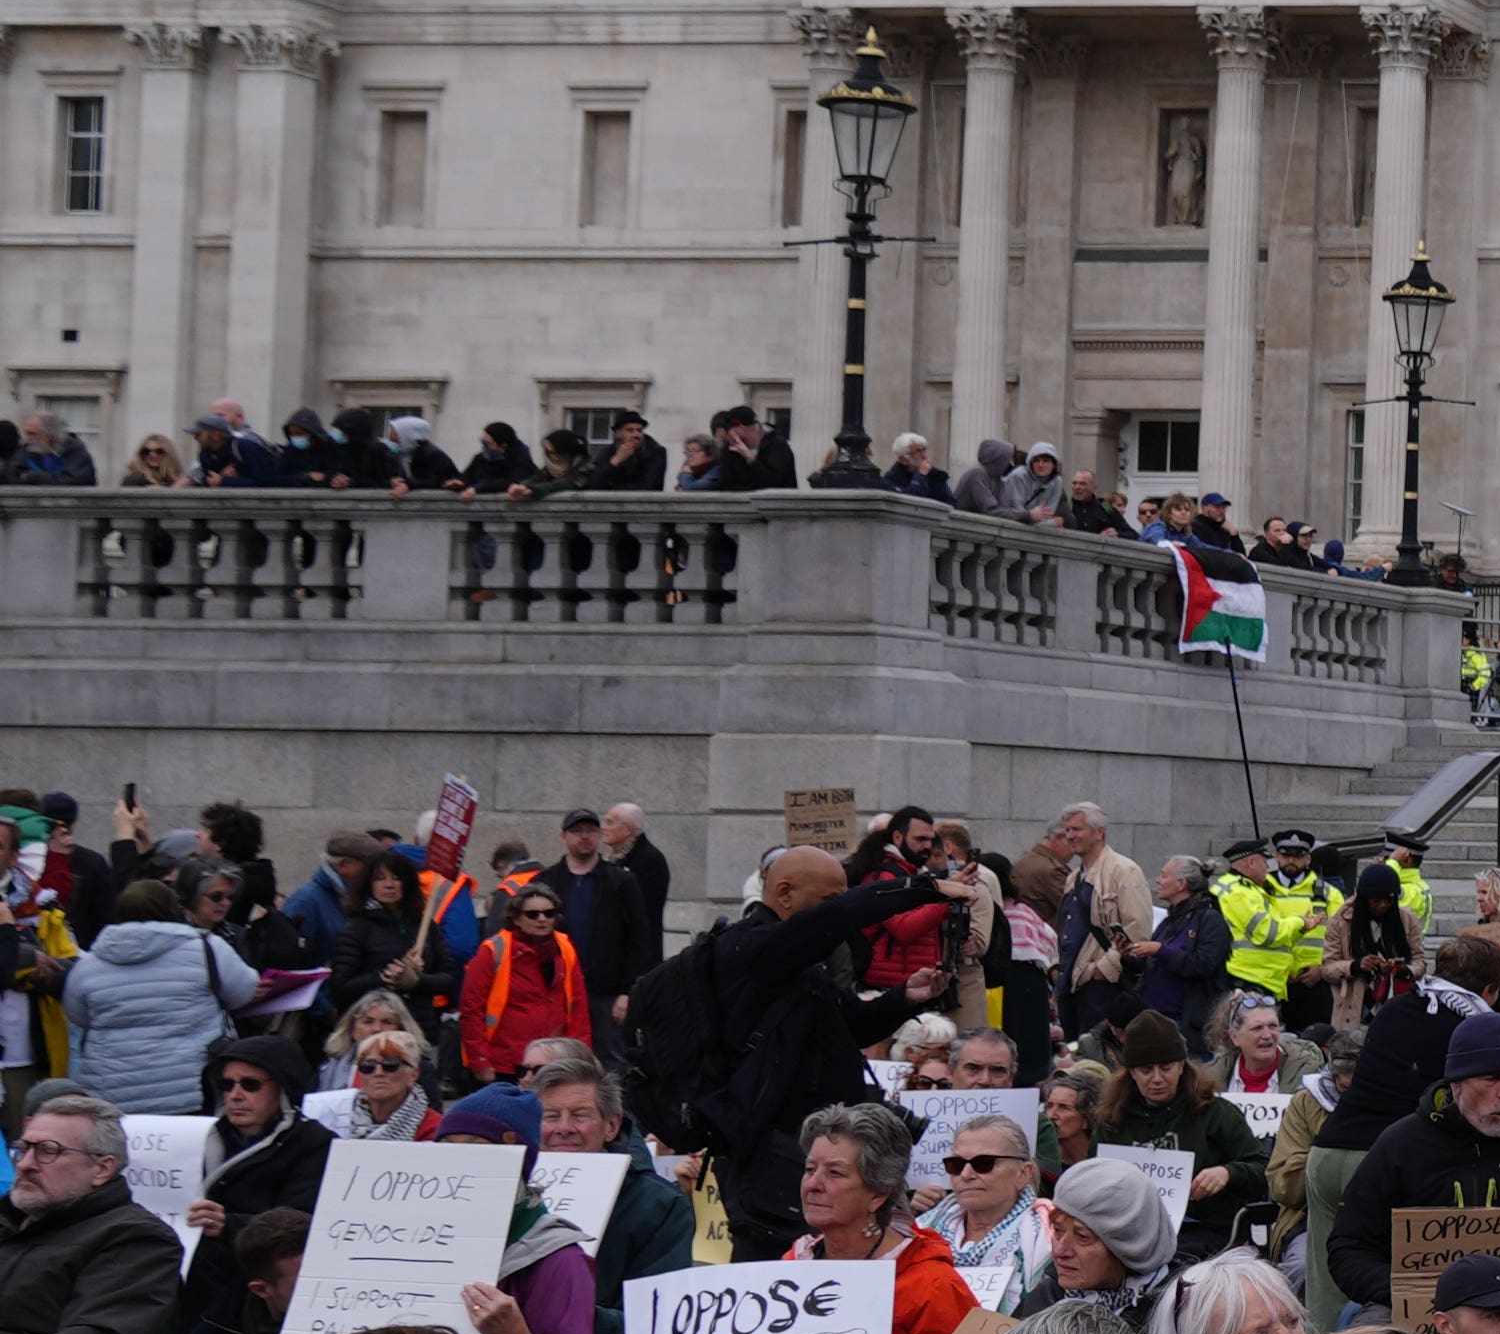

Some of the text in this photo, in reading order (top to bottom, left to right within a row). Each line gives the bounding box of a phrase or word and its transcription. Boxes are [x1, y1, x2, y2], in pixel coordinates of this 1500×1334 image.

[343, 1165, 476, 1201] I OPPOSE
[328, 1220, 454, 1250] GENOCIDE
